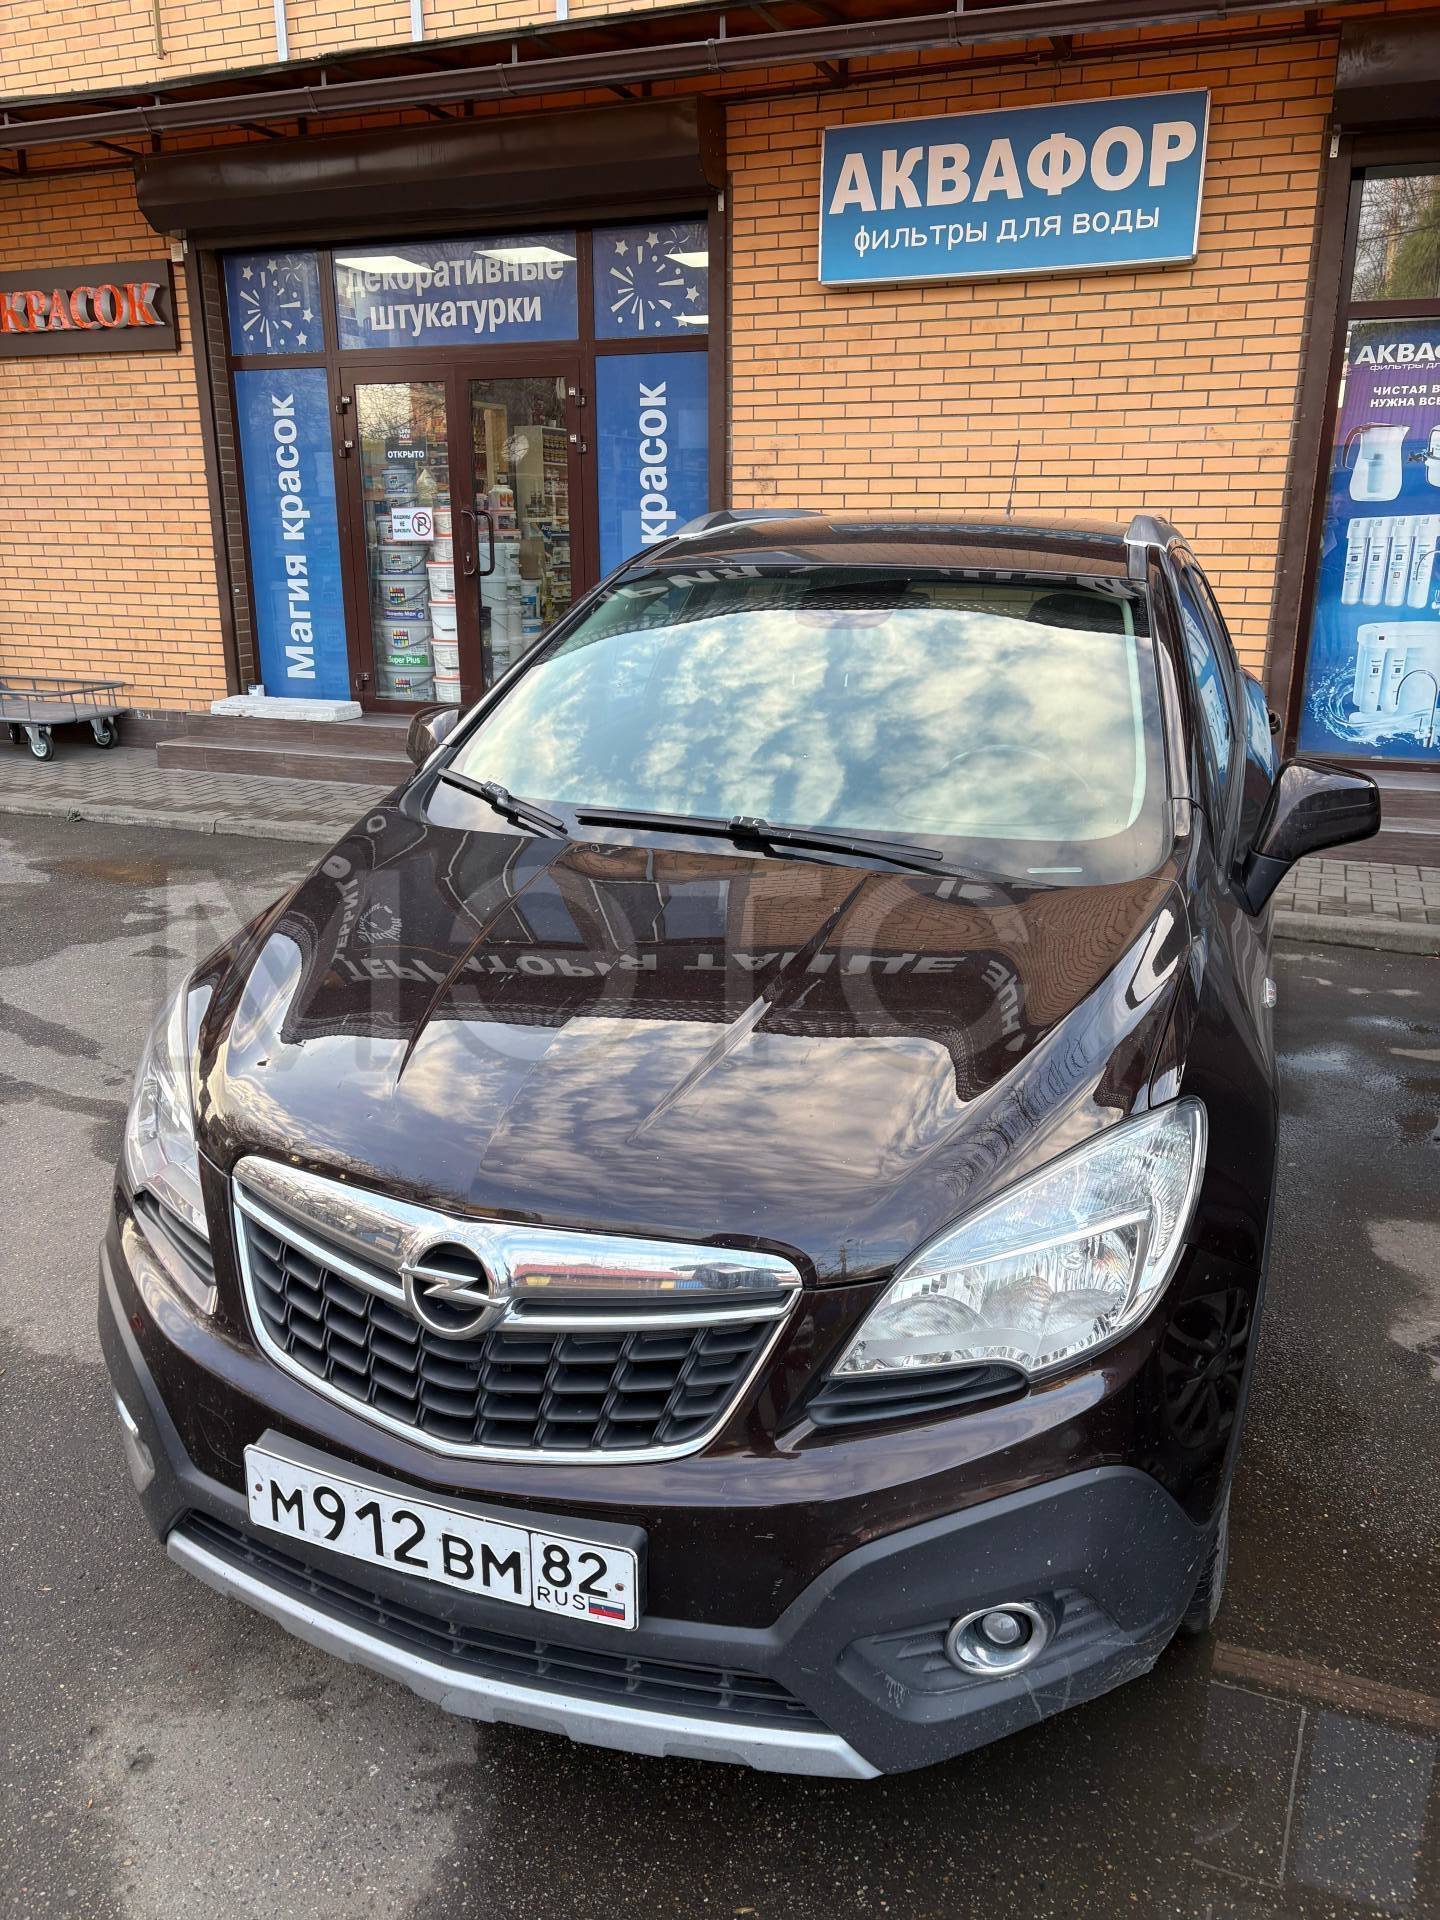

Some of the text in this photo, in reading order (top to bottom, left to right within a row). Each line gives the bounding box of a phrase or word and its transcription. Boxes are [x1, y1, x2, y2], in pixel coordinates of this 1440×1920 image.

[828, 120, 1197, 215] АКВАФОР
[853, 206, 1160, 258] фильтры для воды
[0, 282, 166, 334] КРАСОК
[369, 295, 542, 337] штукатурки
[1369, 363, 1424, 373] фильтры
[1373, 384, 1427, 396] ЧИСТАЯ
[1369, 397, 1415, 408] НУЖНА
[387, 450, 425, 459] ОТКРЫТО
[638, 380, 677, 544] красок
[271, 393, 316, 680] Магия красок
[542, 1543, 609, 1598] 82
[536, 1586, 586, 1611] RUS
